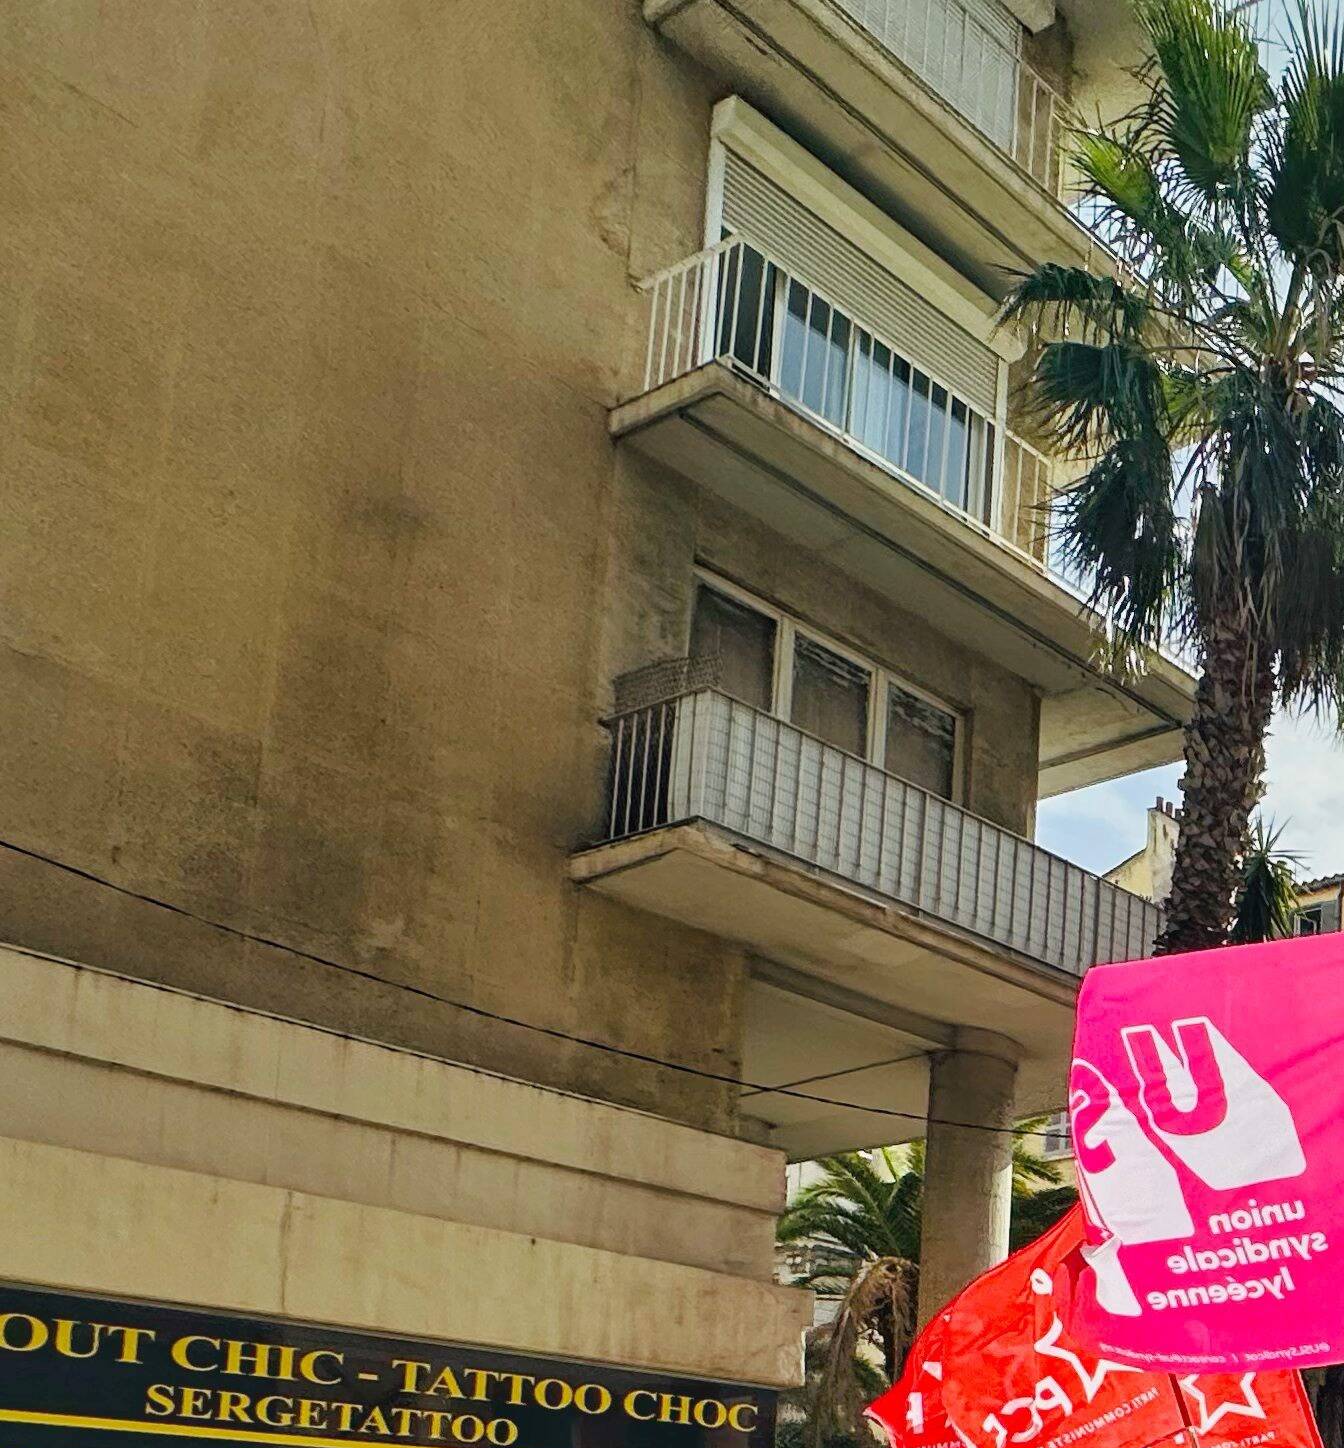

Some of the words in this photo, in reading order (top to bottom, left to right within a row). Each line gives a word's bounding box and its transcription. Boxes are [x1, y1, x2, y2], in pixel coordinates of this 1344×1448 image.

[145, 1383, 519, 1446] SERGETATTOO
[171, 1335, 345, 1385] CHIC
[392, 1359, 612, 1414] TATTOO
[624, 1390, 759, 1432] CHOC
